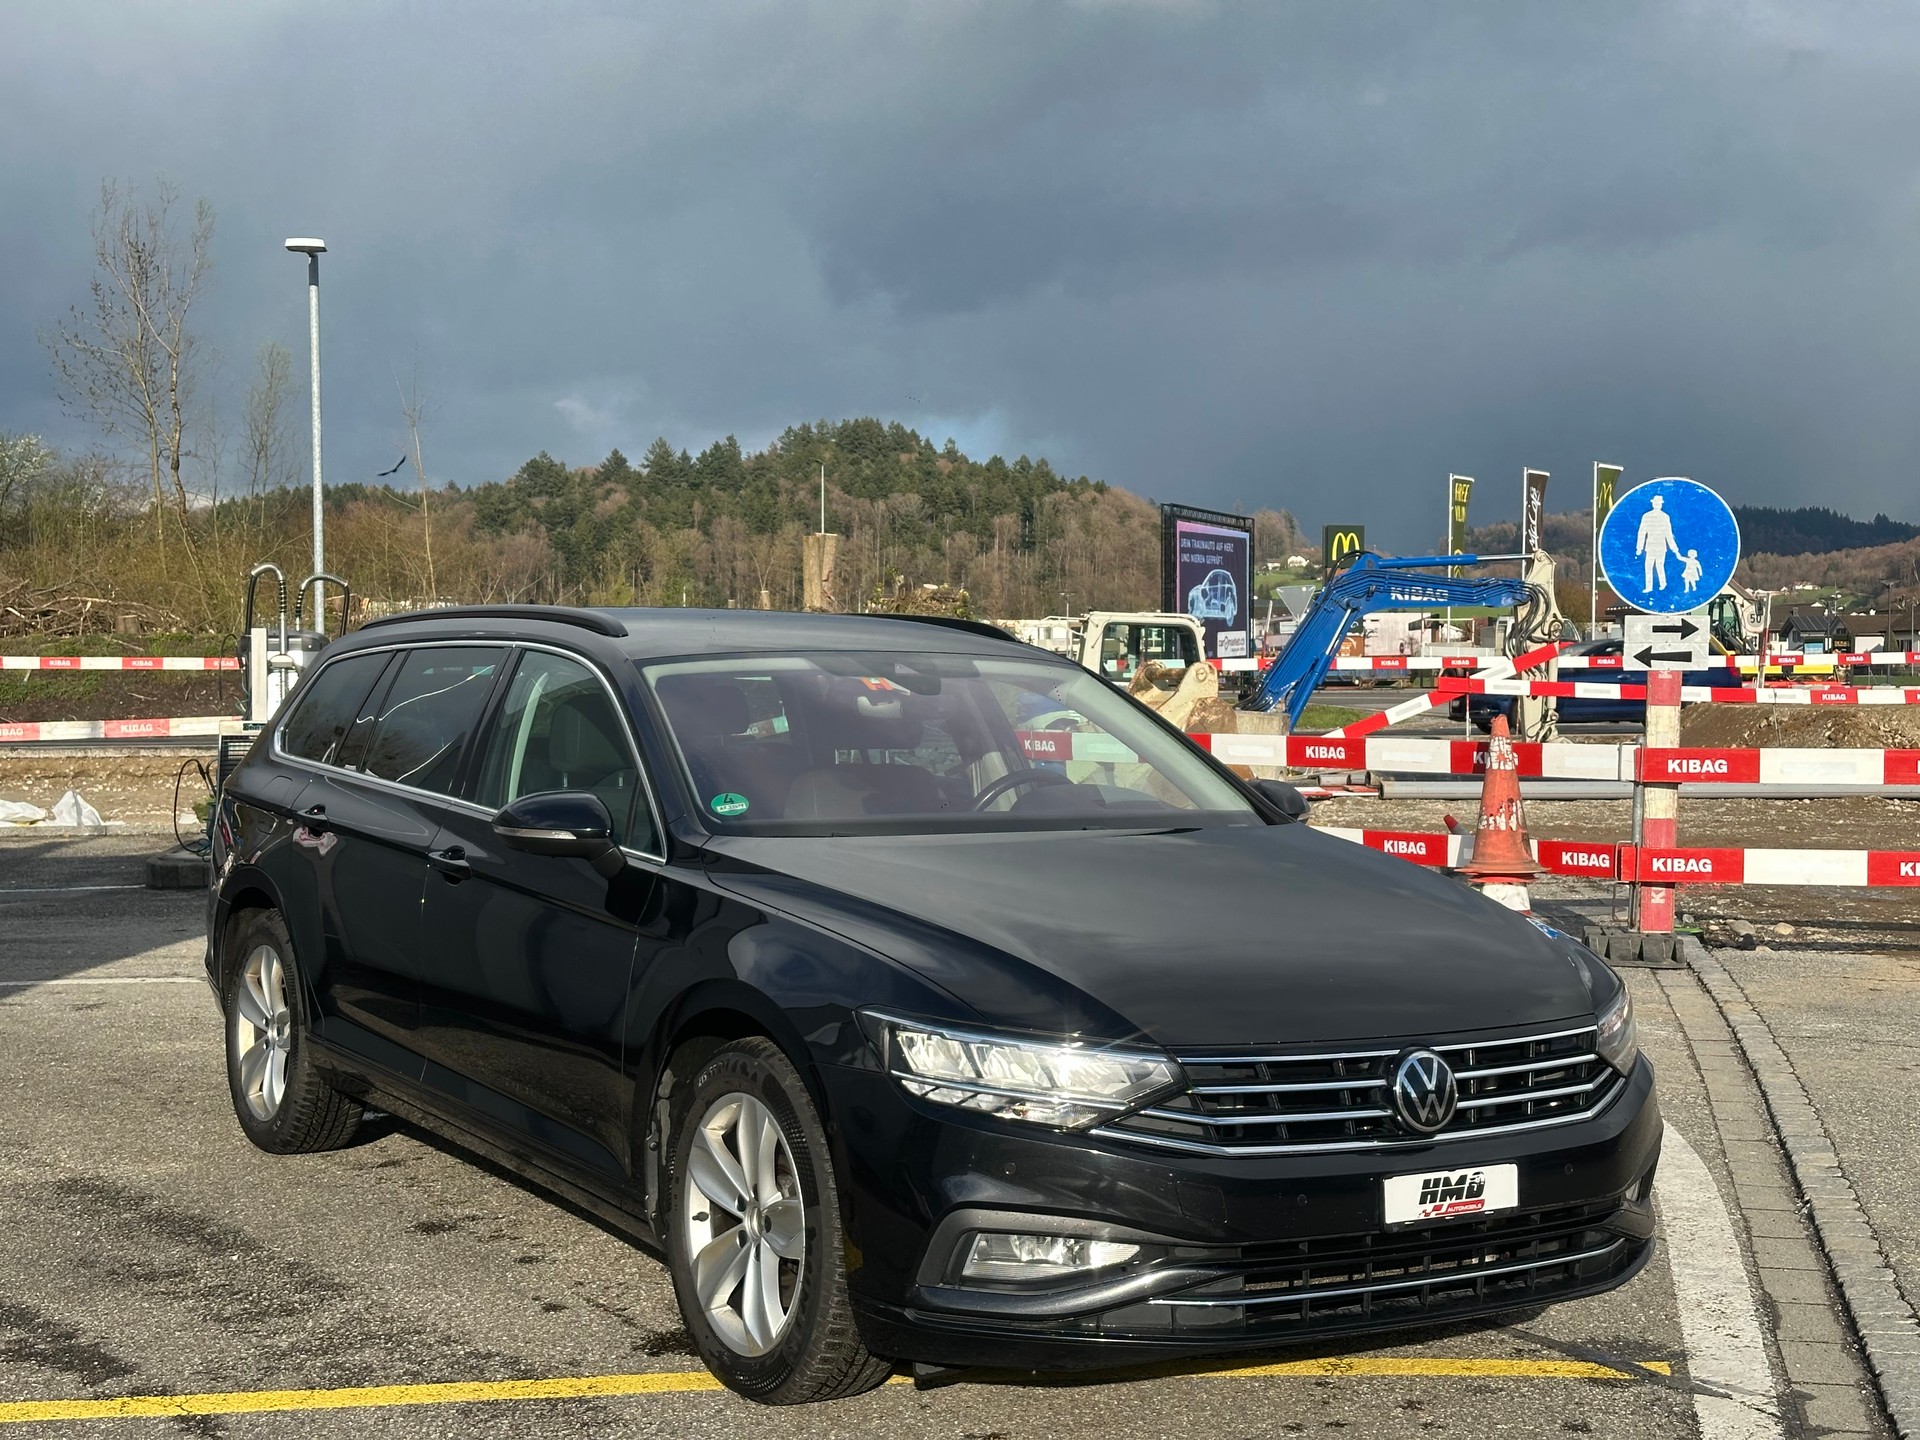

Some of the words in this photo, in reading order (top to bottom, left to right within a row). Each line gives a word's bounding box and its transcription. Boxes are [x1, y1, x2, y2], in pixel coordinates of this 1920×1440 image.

[1822, 693, 1847, 701] KIBAG
[120, 724, 153, 733] KIBAG
[1305, 745, 1346, 760] KIBAG
[1667, 759, 1728, 774] KIBAG
[1383, 839, 1427, 855] KIBAG
[1561, 851, 1611, 868] KIBAG
[1652, 857, 1713, 873] KIBAG
